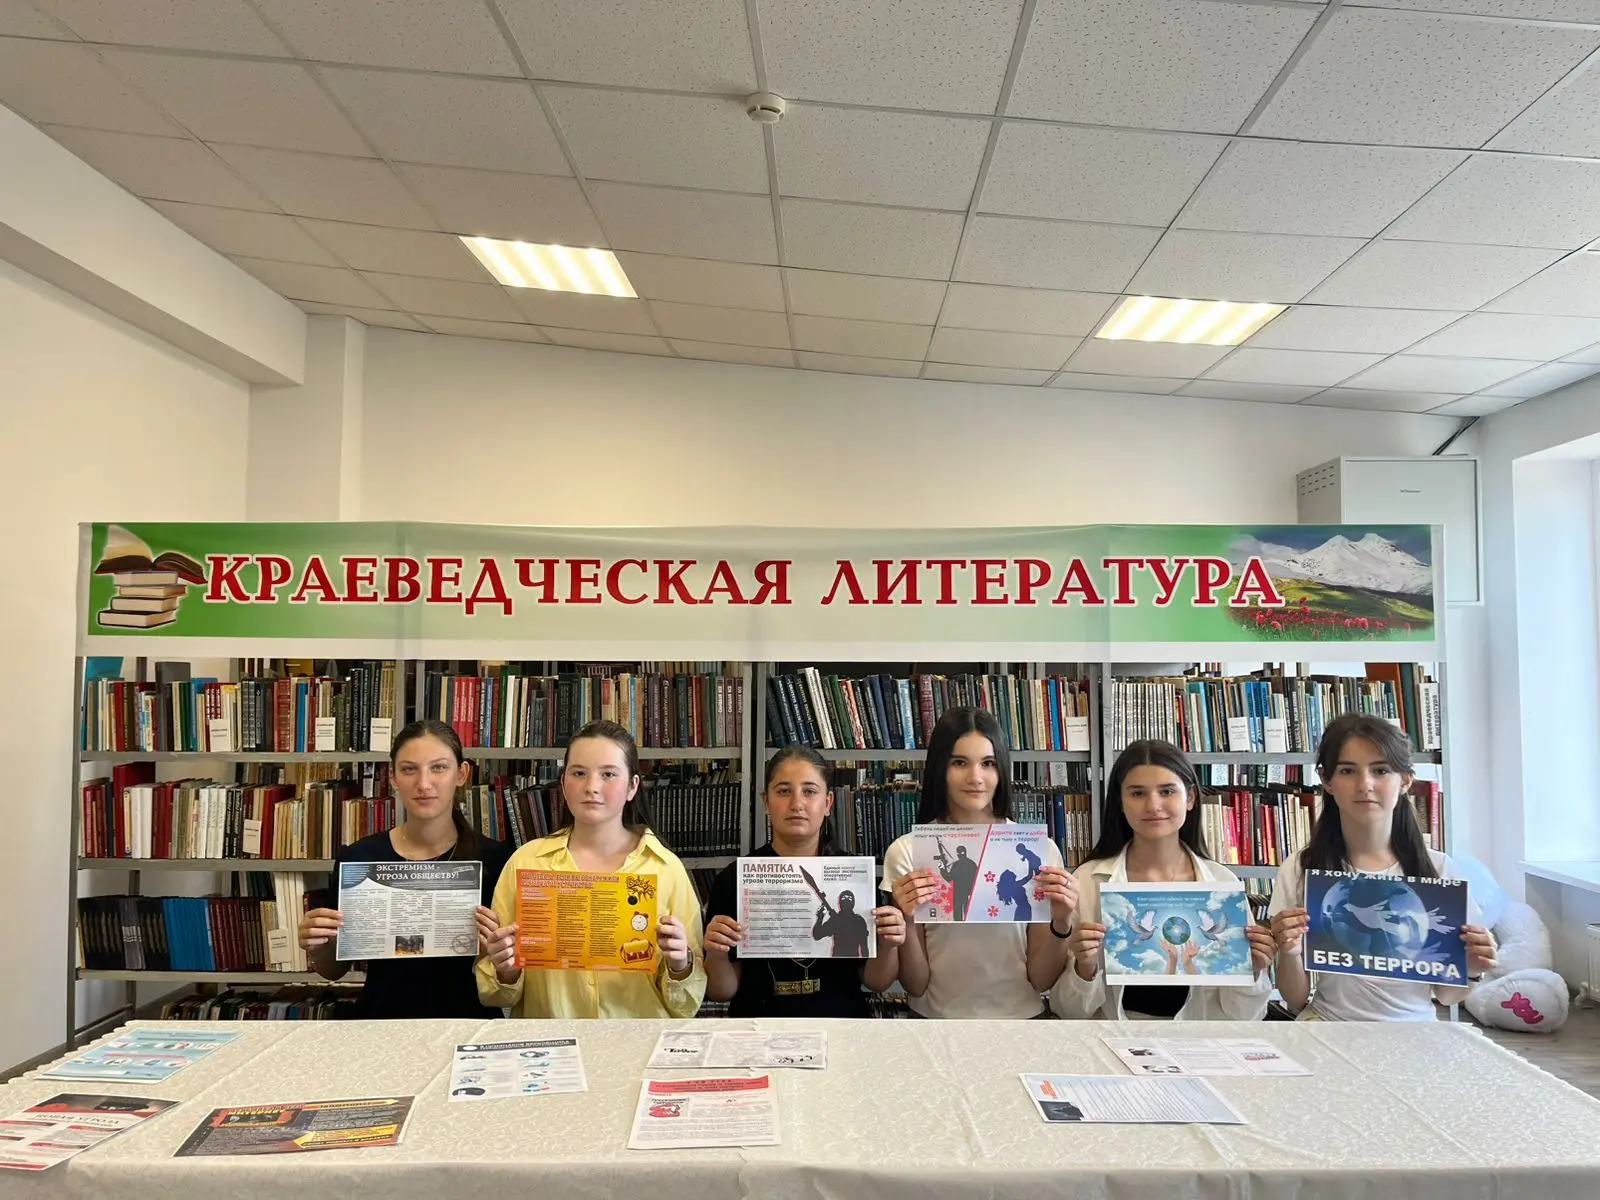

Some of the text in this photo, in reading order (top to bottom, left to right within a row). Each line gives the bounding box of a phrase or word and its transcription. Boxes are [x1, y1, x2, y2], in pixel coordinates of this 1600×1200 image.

[204, 555, 1285, 615] КРАЕВЕДЧЕСКАЯ ЛИТЕРАТУРА
[376, 864, 435, 872] ЭКСТРЕМИЗМ
[743, 863, 794, 873] ПАМЯТКА
[376, 873, 409, 881] УГРОЗА
[410, 871, 460, 880] ОБЩЕСТВУ!
[1325, 870, 1360, 881] хочу
[1364, 872, 1403, 882] жить
[1420, 876, 1462, 888] мире
[1313, 949, 1462, 979] БЕЗ ТЕРРОРА
